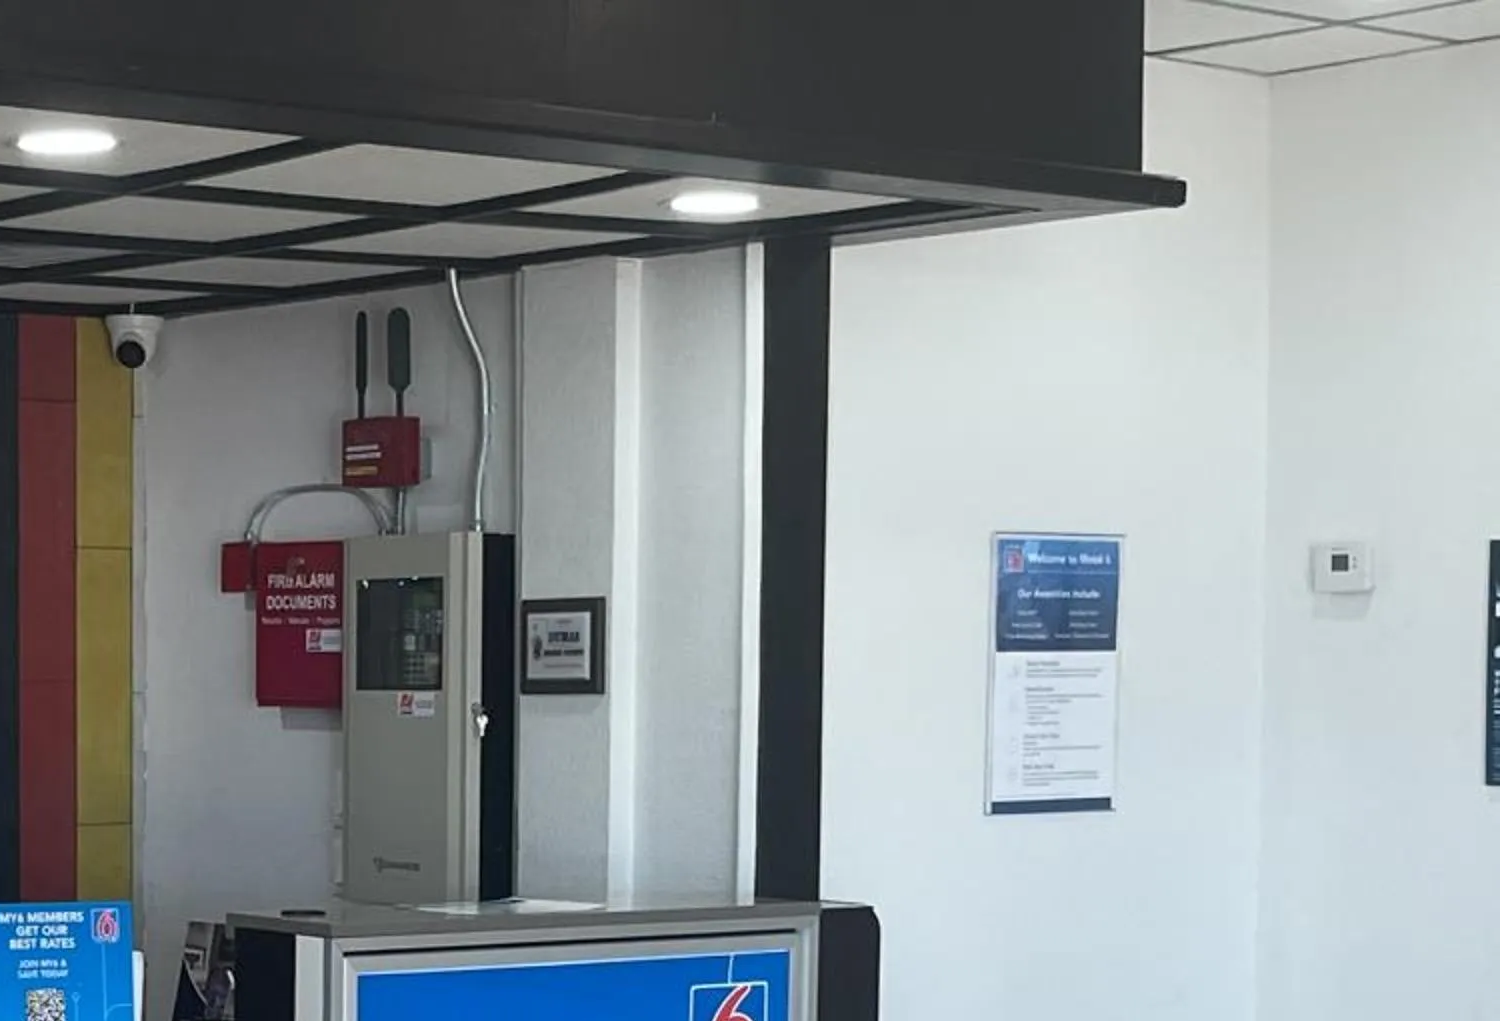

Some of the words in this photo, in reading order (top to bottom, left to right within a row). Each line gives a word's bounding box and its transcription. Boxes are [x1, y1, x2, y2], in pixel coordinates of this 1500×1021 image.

[295, 572, 335, 589] ALARM
[265, 594, 337, 611] DOCUMENTS
[26, 911, 85, 923] MEMBERS
[15, 925, 39, 937] GET
[41, 924, 69, 936] OUR
[9, 938, 37, 950] BEST
[40, 937, 77, 949] RATES
